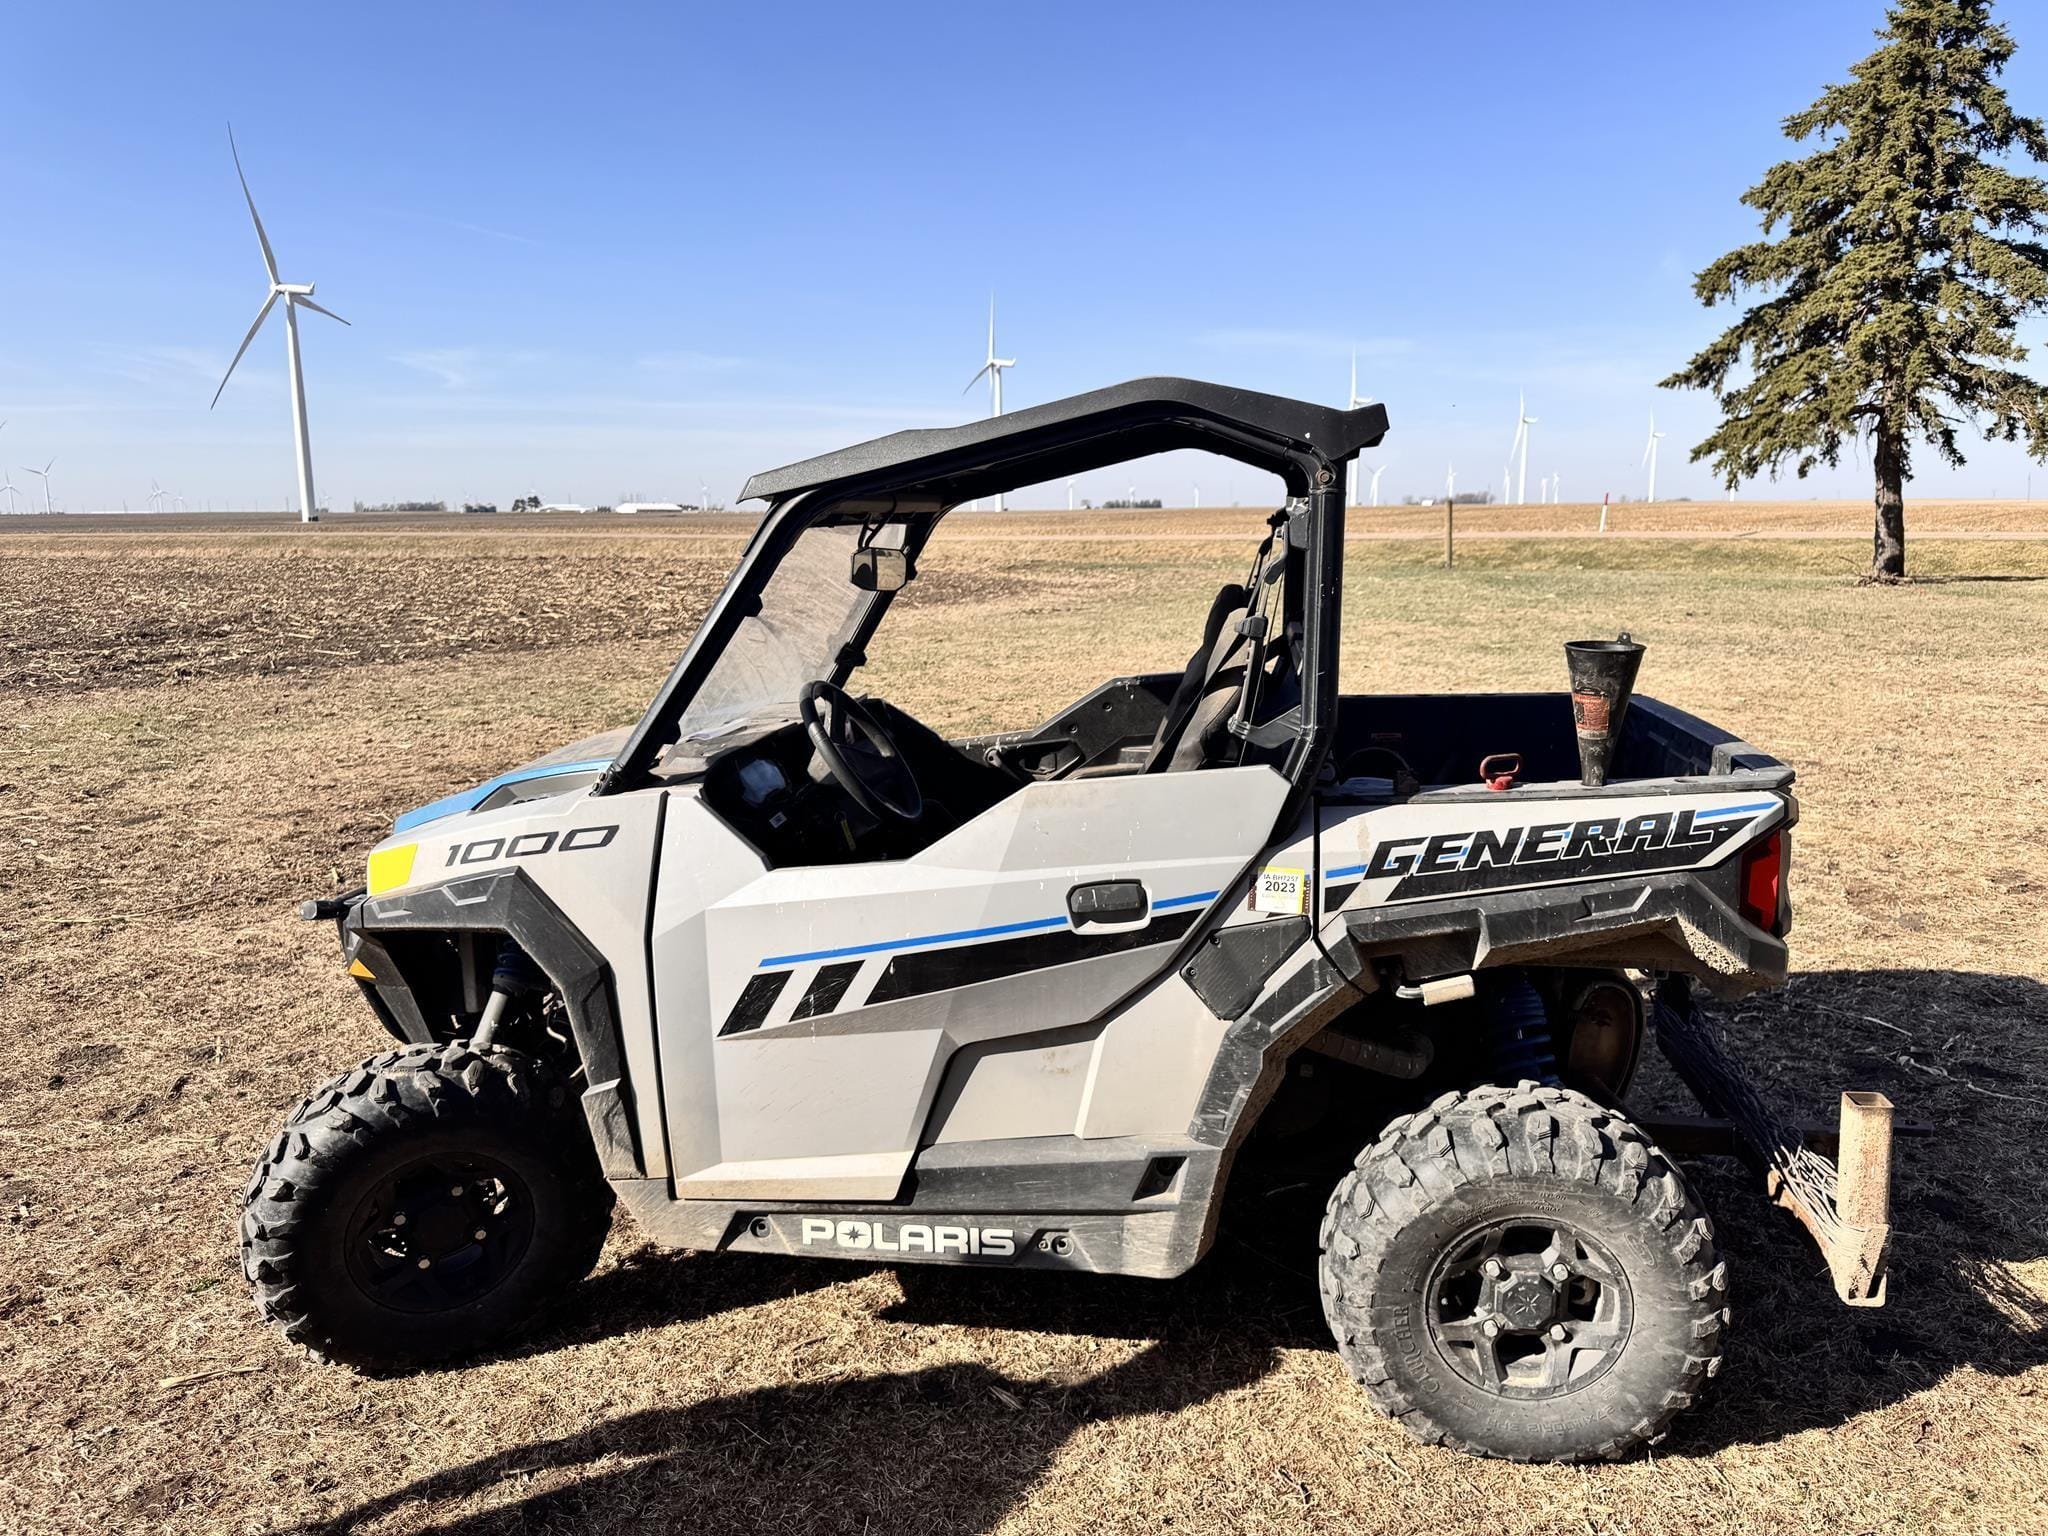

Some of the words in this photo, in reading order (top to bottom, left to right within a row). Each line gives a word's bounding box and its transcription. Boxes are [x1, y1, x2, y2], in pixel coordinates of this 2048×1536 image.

[445, 824, 620, 867] 1000
[1362, 810, 1714, 880] GENERAL
[1265, 881, 1295, 892] 2023
[801, 1218, 1016, 1257] POLARIS
